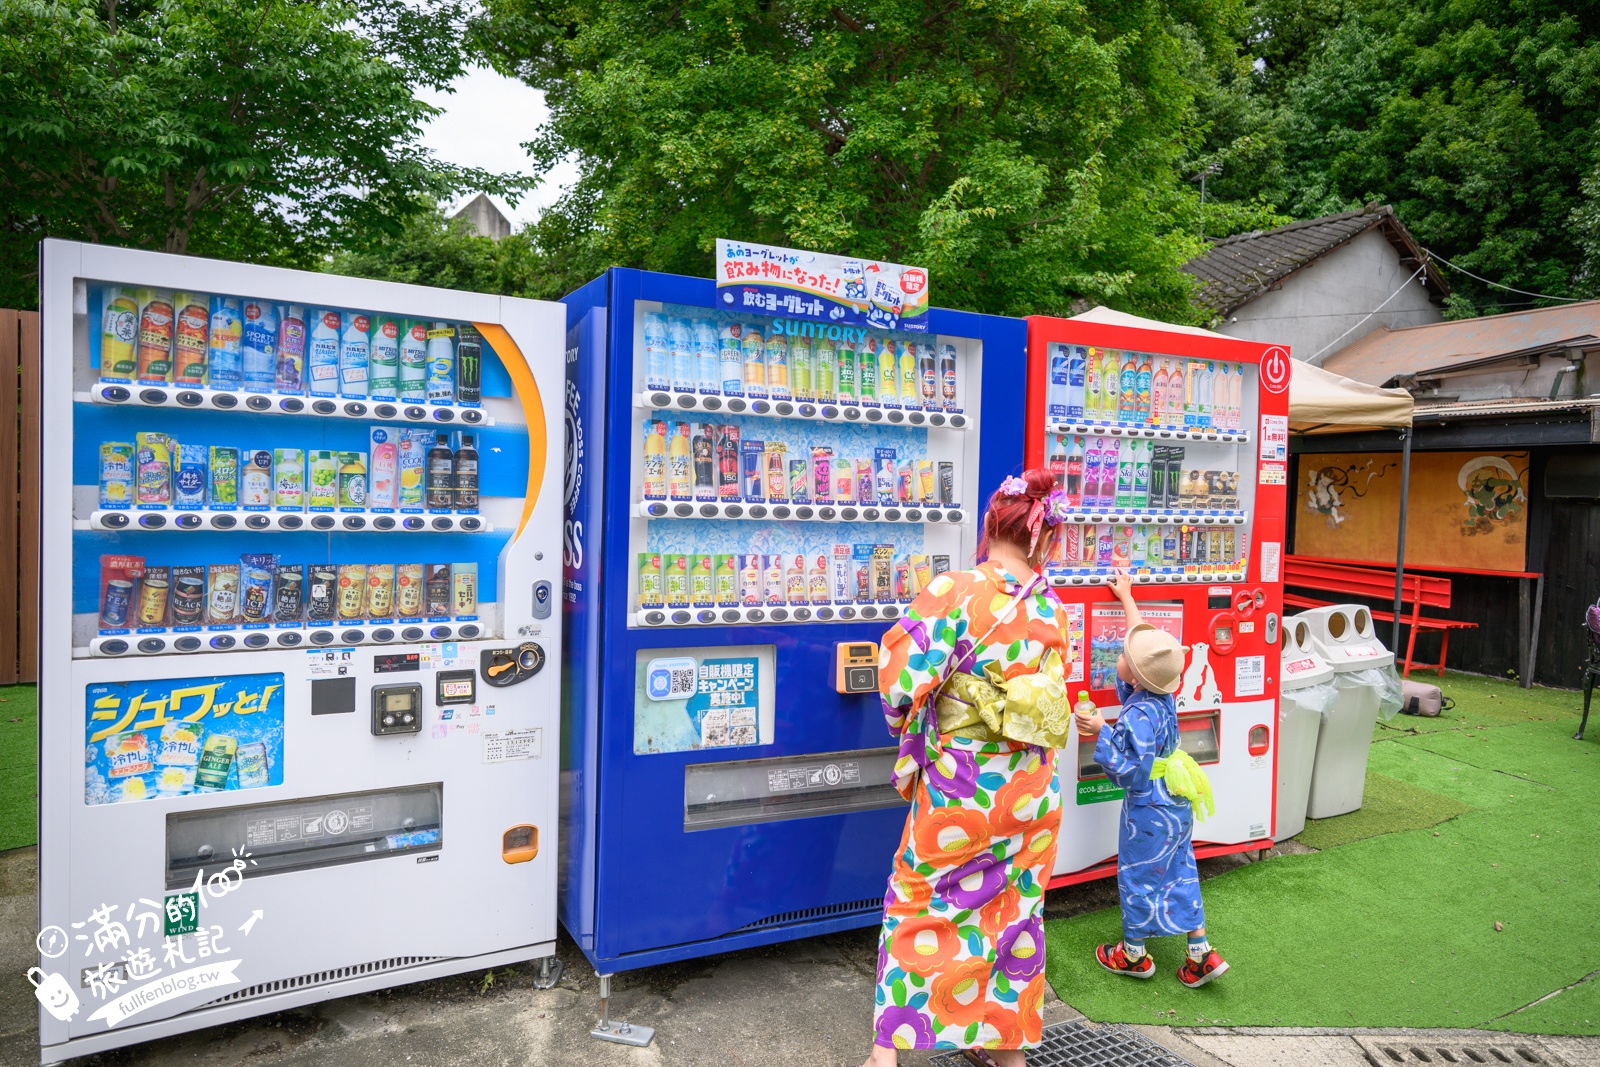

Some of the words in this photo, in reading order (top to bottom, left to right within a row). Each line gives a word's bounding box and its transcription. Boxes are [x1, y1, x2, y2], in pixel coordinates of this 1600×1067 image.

[726, 243, 800, 265] あのヨーグレットが
[723, 260, 841, 294] 飲み物になった!
[903, 273, 924, 284] 自販機
[905, 281, 920, 291] 限定
[742, 290, 825, 317] 飲むヨーグレット
[772, 318, 868, 343] SUNTORY
[246, 330, 275, 342] SPORTS
[248, 337, 270, 345] CHARGE
[576, 416, 584, 459] BOSS
[104, 461, 130, 471] 冷やし
[214, 467, 236, 475] メロン
[311, 490, 335, 498] 白ぶどう
[569, 463, 583, 516] COFFEE
[833, 546, 851, 554] 満足感
[109, 560, 144, 568] 濃厚紅茶!
[250, 556, 277, 565] キリッと
[107, 594, 129, 606] TEA
[174, 599, 202, 608] BLACK
[246, 600, 264, 608] ICE
[278, 601, 297, 609] BLACK
[312, 601, 331, 609] BLACK
[699, 663, 755, 679] 自販機限定
[698, 678, 754, 693] キャンペーン
[709, 691, 746, 706] 実施中!
[89, 682, 284, 744] シュワッと!
[163, 741, 198, 754] 冷やし
[113, 750, 148, 766] 冷やし
[202, 754, 230, 764] GINGER
[208, 762, 223, 770] ALE
[169, 925, 194, 934] WIND
